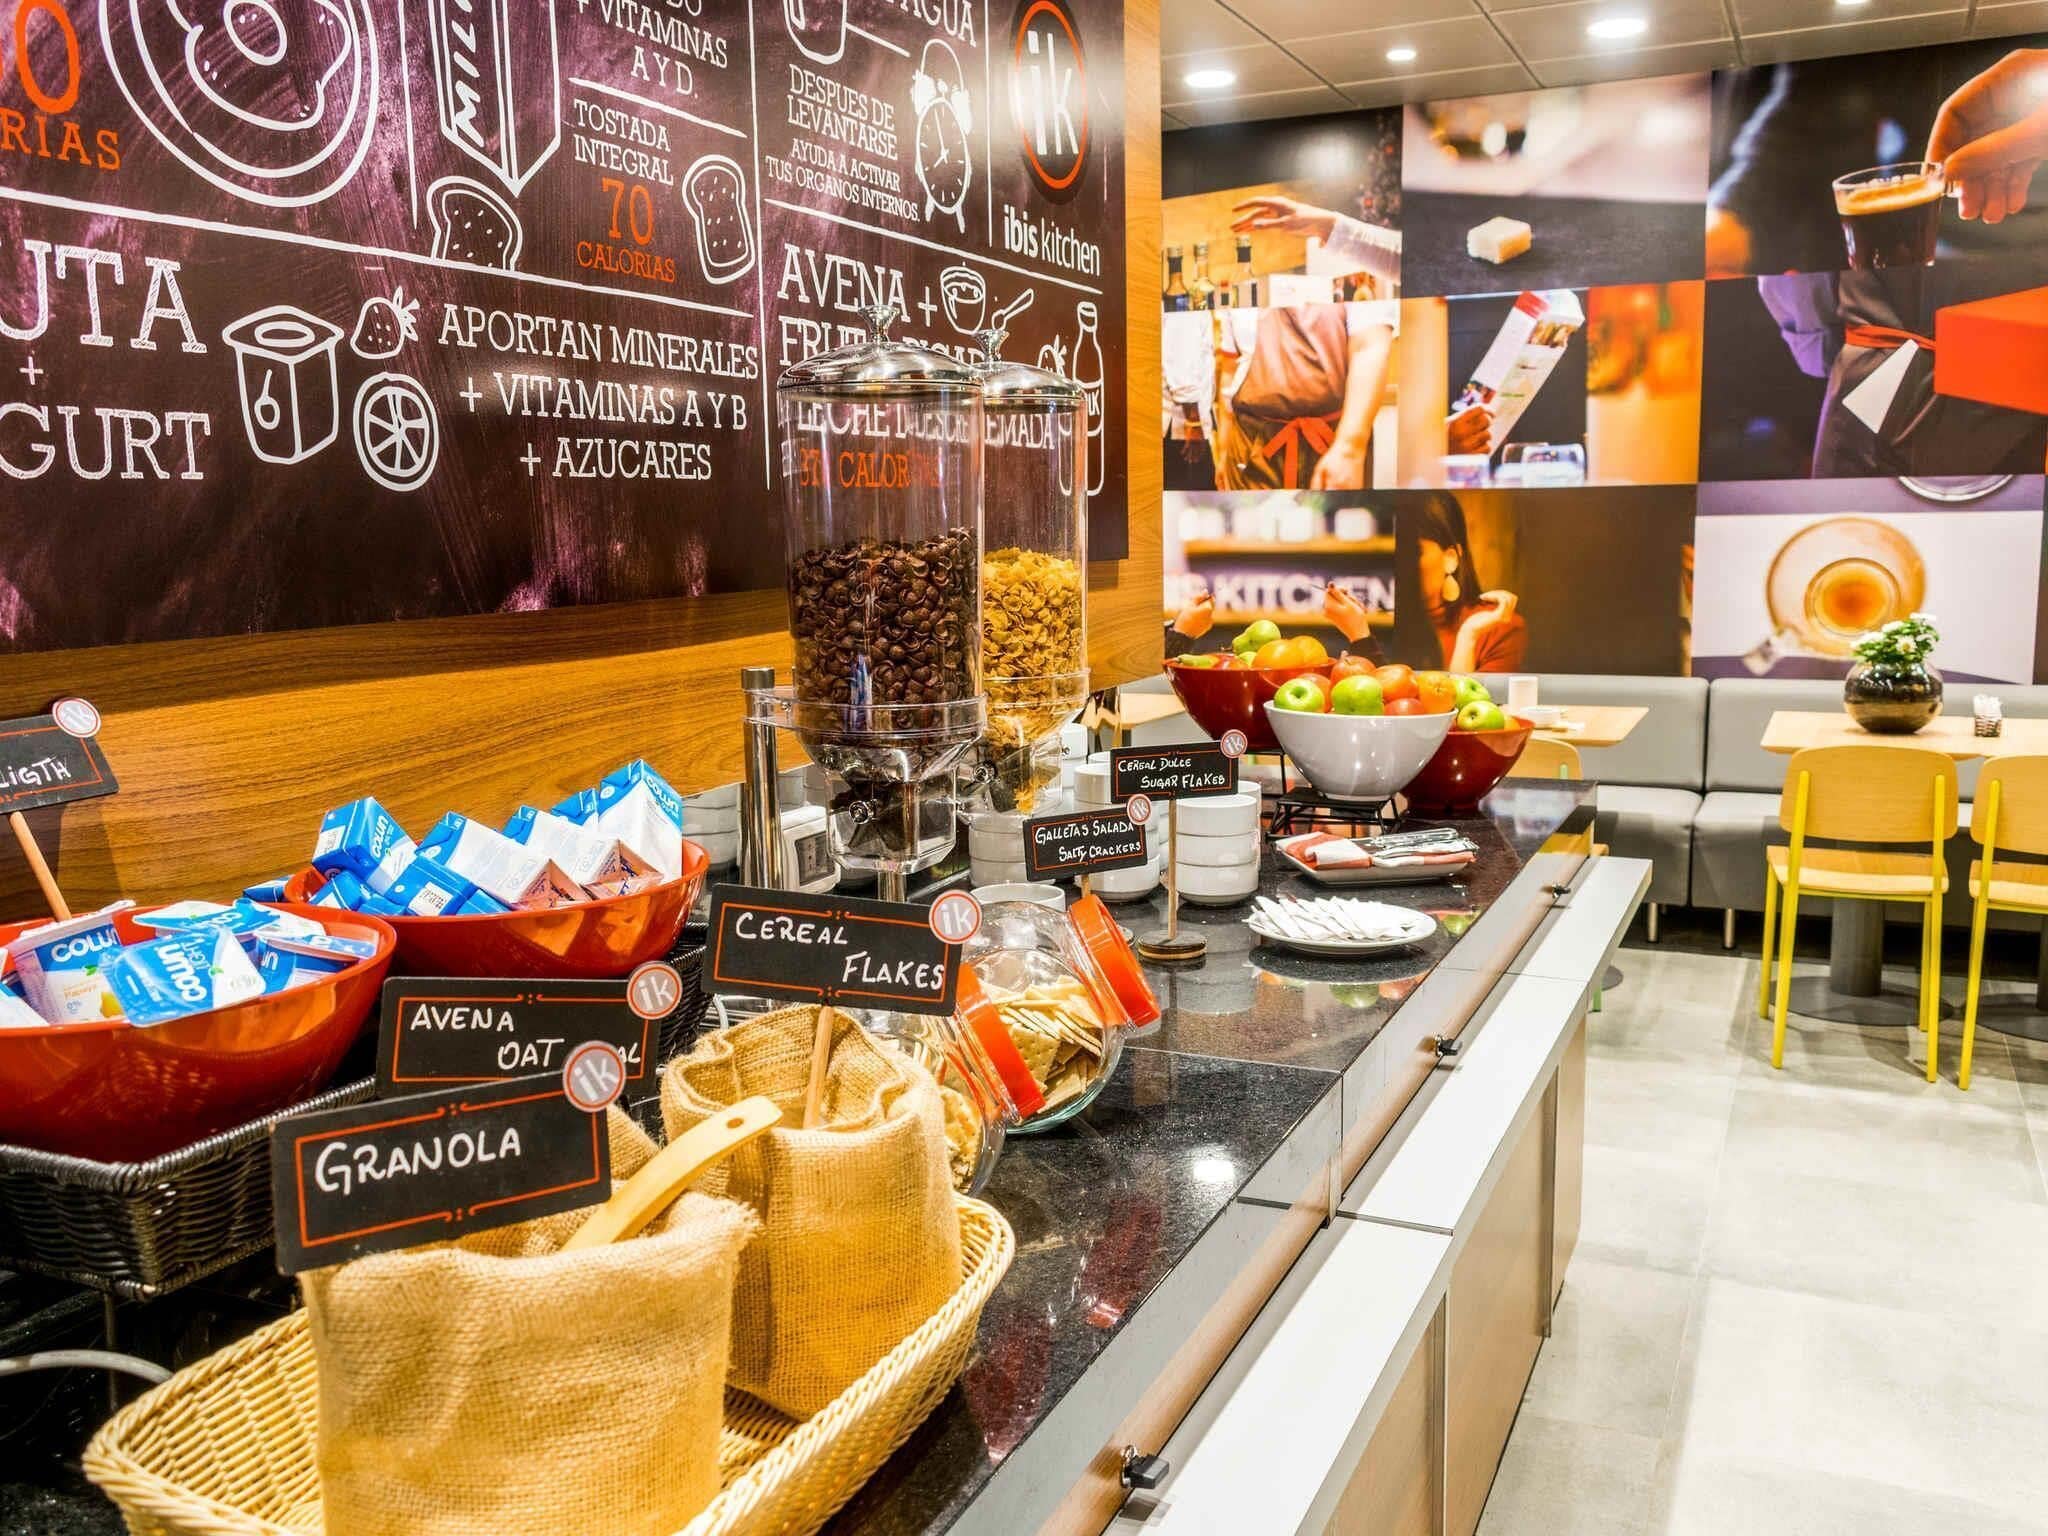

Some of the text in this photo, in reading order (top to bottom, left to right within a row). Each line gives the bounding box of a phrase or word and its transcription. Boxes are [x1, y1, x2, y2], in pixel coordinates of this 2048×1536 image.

[601, 0, 728, 68] VITAMINAS
[450, 0, 485, 148] MIL
[630, 45, 650, 81] A
[653, 52, 670, 87] Y
[789, 63, 895, 131] DESPUES DE
[1027, 30, 1079, 156] ik
[574, 98, 671, 152] TOSTADA
[787, 94, 898, 160] LEVANTARSE
[573, 133, 674, 186] INTEGRAL
[791, 138, 900, 193] AYUDA A ACTIVAR
[602, 177, 654, 245] 70
[765, 155, 920, 222] TUS ORGANOS INTERNOS.
[577, 241, 676, 283] CALORIAS
[1004, 203, 1100, 277] ibis kitchen
[778, 243, 938, 327] AVENA +
[438, 303, 758, 380] APORTAN MINERALES
[19, 356, 44, 386] +
[459, 372, 747, 431] + VITAMINAS A Y B
[0, 403, 211, 481] GURT
[520, 437, 712, 480] + AZUCARES
[1118, 757, 1192, 773] CEREAL DULCE
[1140, 775, 1179, 790] SUGAR
[1035, 823, 1090, 845] GALLETAS
[1089, 841, 1141, 858] CRACKERS
[735, 912, 848, 946] CEREAL
[941, 903, 973, 936] ik
[636, 976, 674, 1012] ik
[842, 950, 945, 990] FLAKES
[411, 1003, 514, 1032] AVENA
[572, 1052, 620, 1103] ik
[315, 1127, 522, 1195] GRANOLA
